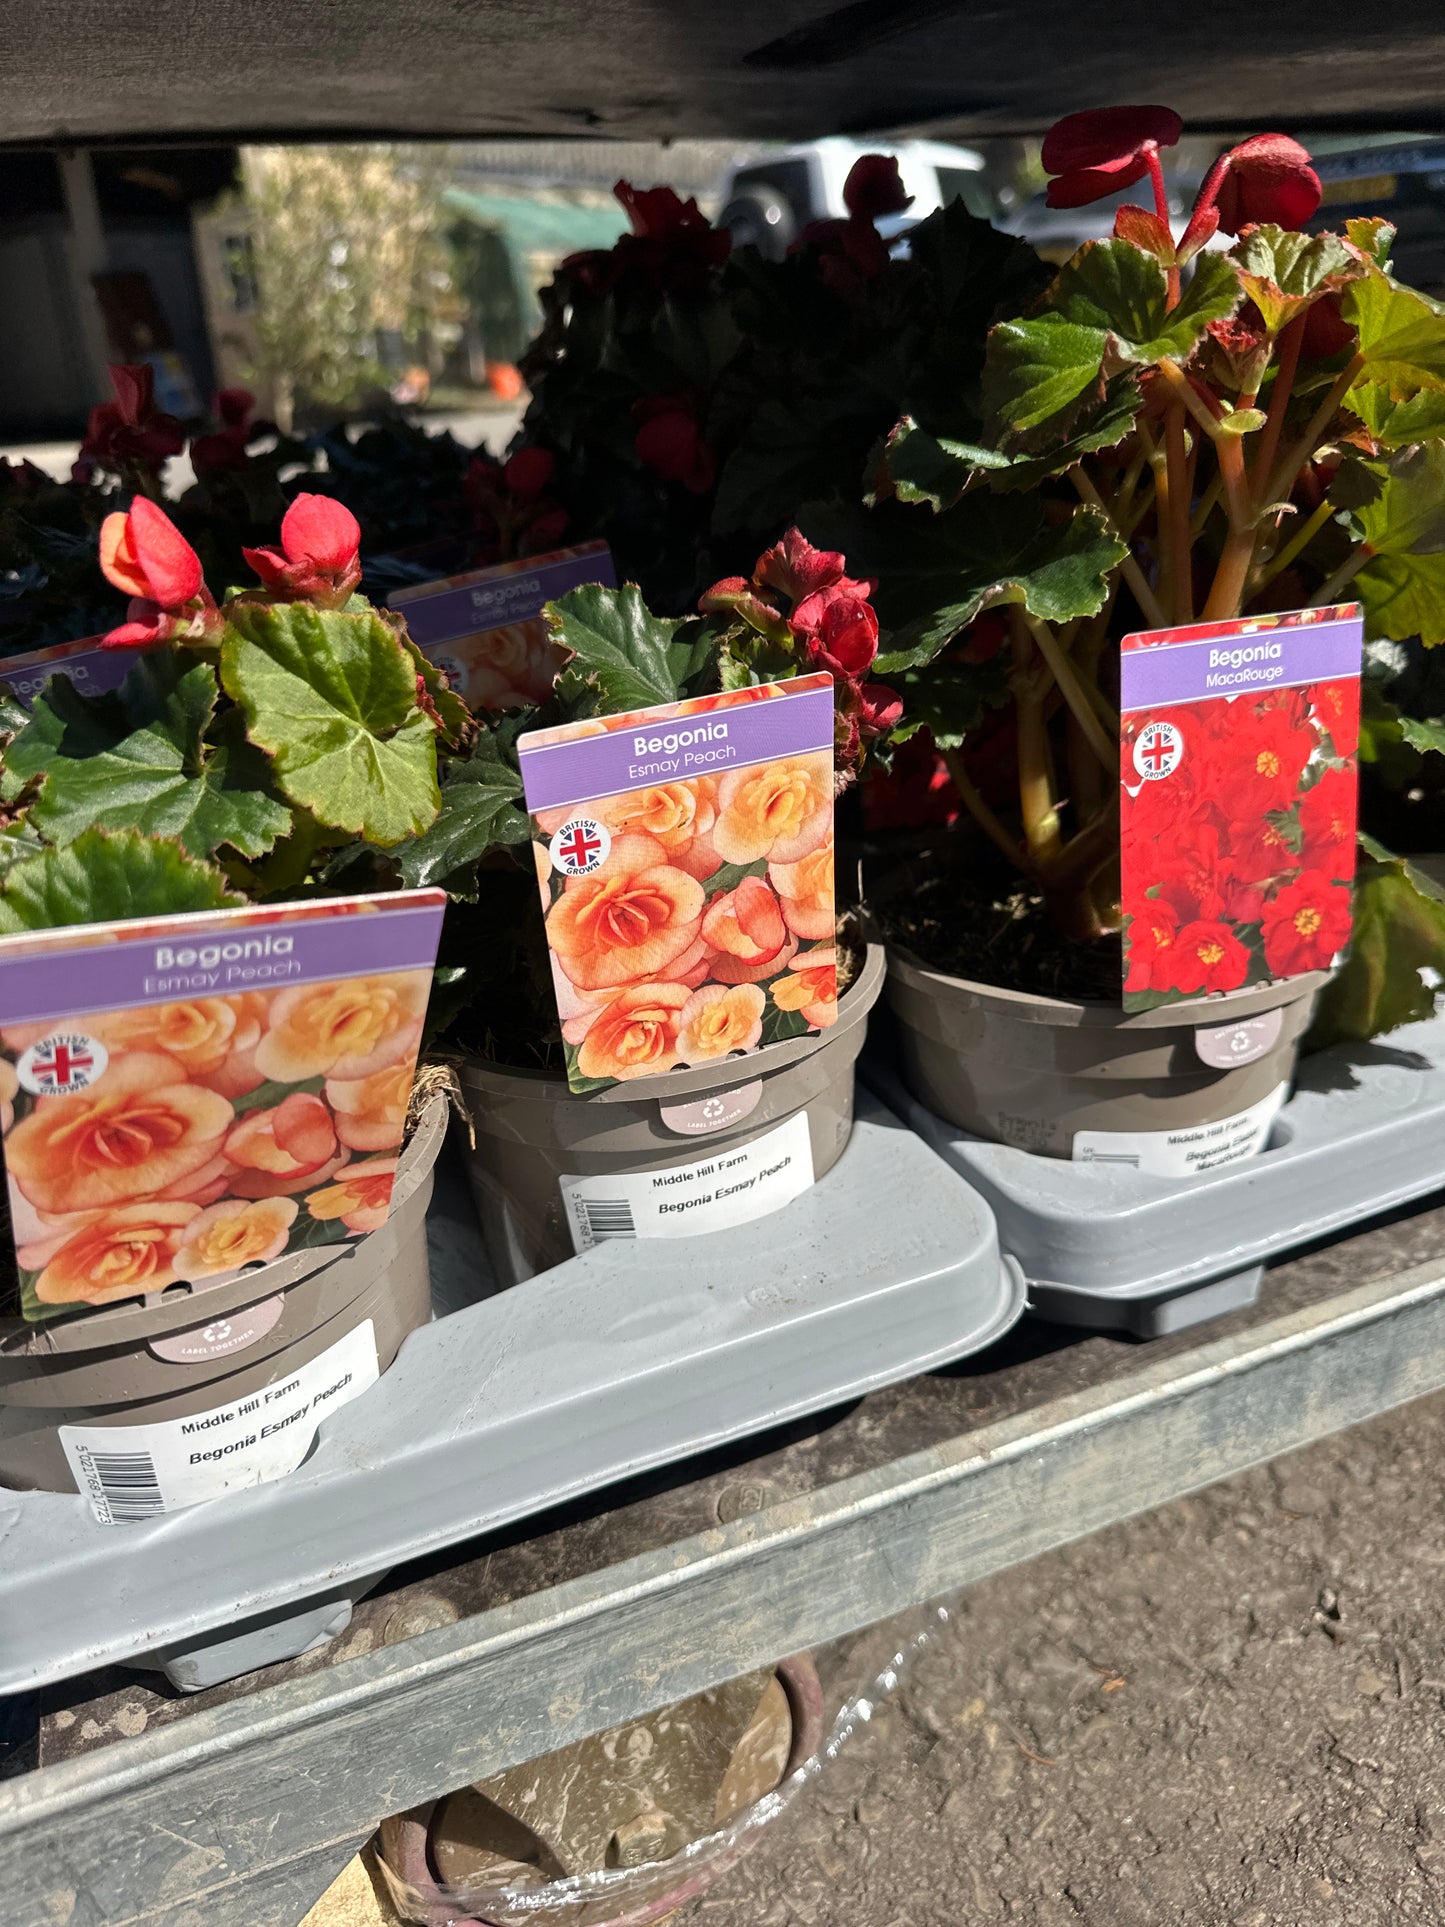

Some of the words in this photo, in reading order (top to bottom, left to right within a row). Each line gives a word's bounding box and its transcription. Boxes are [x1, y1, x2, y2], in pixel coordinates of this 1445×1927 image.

[471, 580, 541, 607] Begonia
[1209, 641, 1282, 669] Begonia
[1206, 666, 1284, 688] MacaRouge
[634, 723, 728, 756] Begonia
[1143, 724, 1173, 738] BRITISH
[628, 758, 680, 779] Esmay
[684, 745, 736, 766] Peach
[1143, 766, 1172, 780] GROWN
[559, 820, 597, 836] BRITISH
[566, 860, 601, 875] GROWN
[156, 934, 295, 971] Begonia
[144, 971, 220, 995] Esmay
[226, 959, 301, 983] Peach
[34, 1035, 90, 1054] BRITISH
[40, 1078, 90, 1095] GROWN
[709, 1109, 743, 1127] TOGETHER
[652, 1173, 695, 1188] Middle
[697, 1164, 714, 1179] Hill
[718, 1153, 748, 1171] Farm
[571, 1192, 582, 1200] 5
[658, 1195, 712, 1214] Begonia
[715, 1176, 756, 1200] Esmay
[759, 1155, 792, 1182] Peach
[210, 1329, 255, 1353] TOGETHER
[181, 1413, 235, 1435] Middle
[238, 1398, 260, 1416] Hill
[264, 1379, 301, 1404] Farm
[189, 1434, 257, 1465] Begonia
[260, 1403, 310, 1439] Esmay
[312, 1372, 353, 1407] Peach
[79, 1455, 102, 1492] 021768
